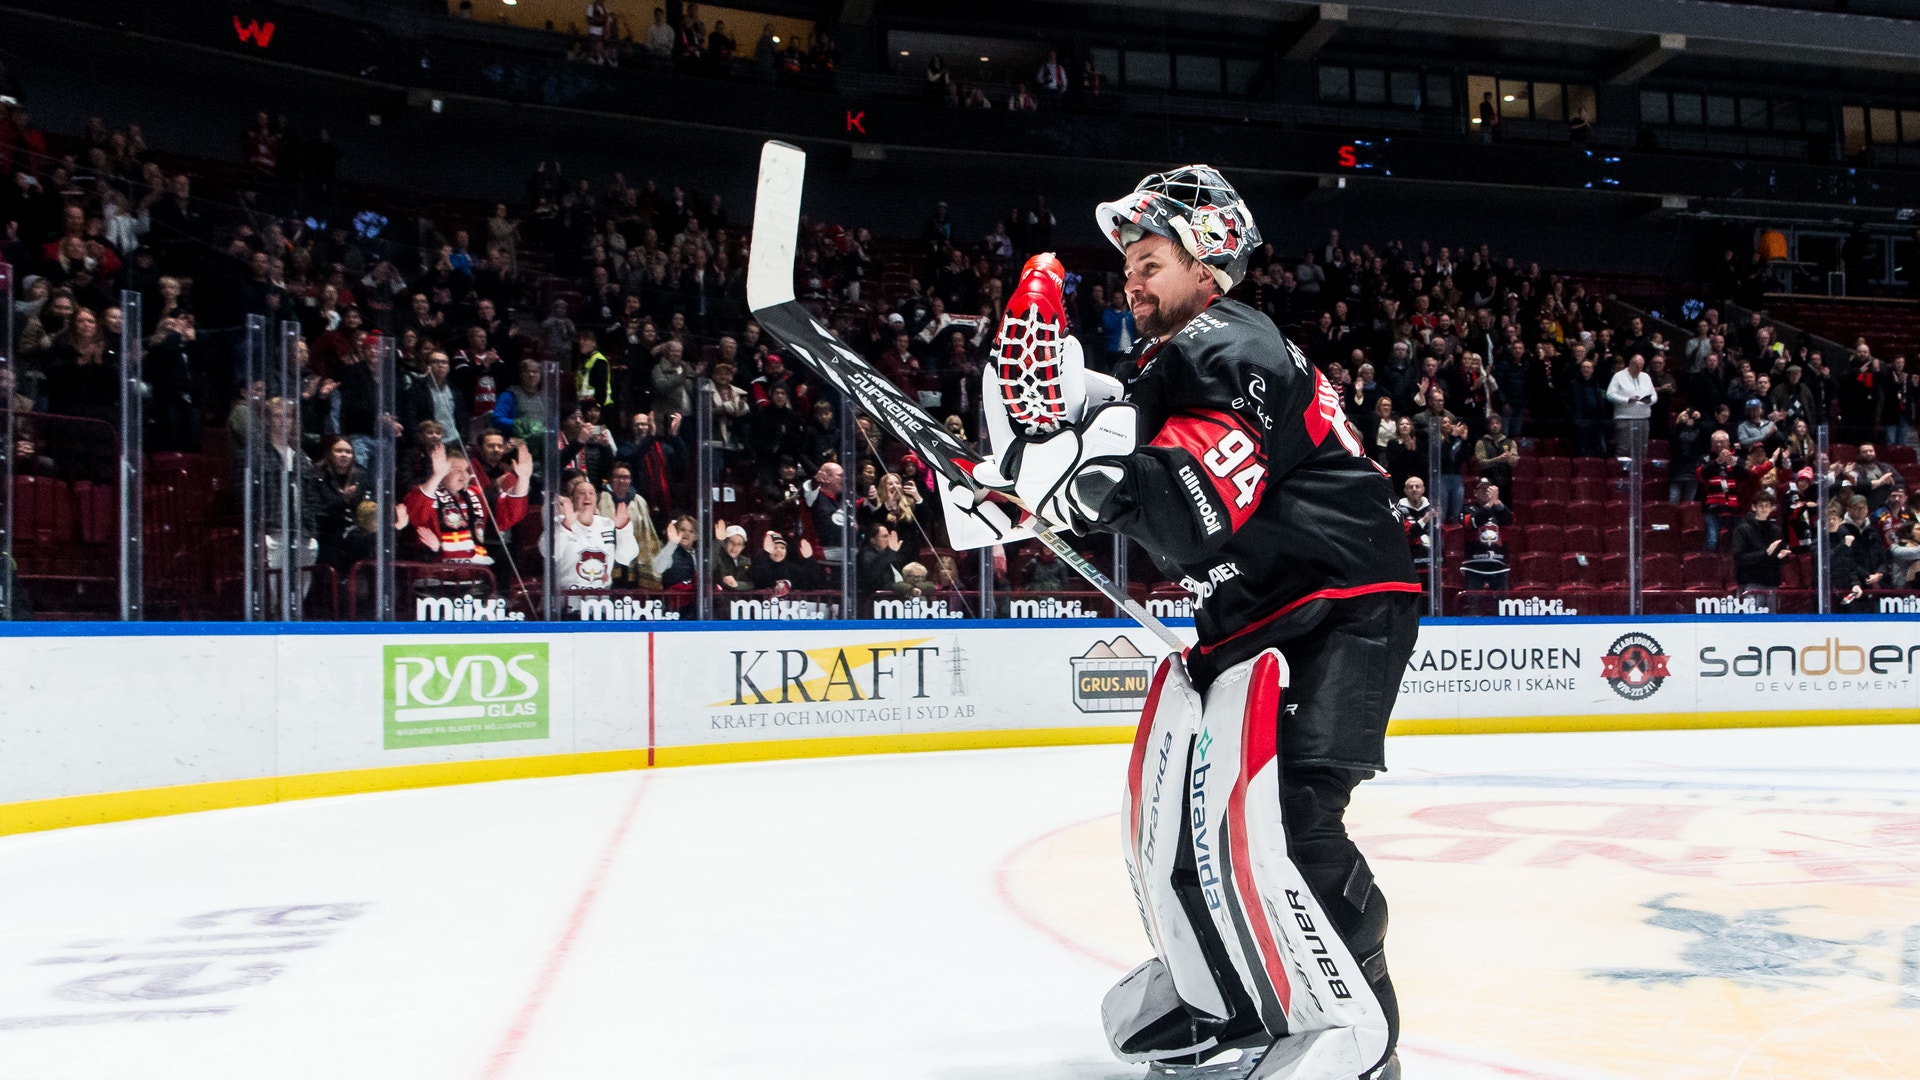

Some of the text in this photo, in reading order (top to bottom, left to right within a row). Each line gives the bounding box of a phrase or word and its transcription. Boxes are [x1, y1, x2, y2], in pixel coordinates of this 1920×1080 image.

[233, 15, 275, 47] W
[846, 110, 865, 135] K
[1338, 144, 1357, 168] S
[847, 371, 924, 433] SUPREME
[1202, 428, 1265, 510] 94
[1178, 465, 1222, 535] tillmobil
[1040, 529, 1110, 588] BAUER
[1146, 596, 1194, 618] mii
[730, 647, 940, 706] KRAFT
[1700, 637, 1920, 677] sandber
[394, 654, 539, 706] RYDS
[1080, 676, 1146, 692] GRUS.NU
[1527, 674, 1576, 691] SKÅNE
[1755, 679, 1909, 692] DEVELOPMENT
[487, 702, 537, 717] GLAS
[710, 712, 768, 729] KRAFT
[774, 710, 810, 726] OCH
[816, 706, 902, 724] MONTAGE
[917, 705, 949, 719] SYD
[954, 704, 975, 718] AB
[1144, 731, 1173, 866] bravida
[1193, 763, 1221, 911] bravida
[1285, 889, 1353, 999] BAUER
